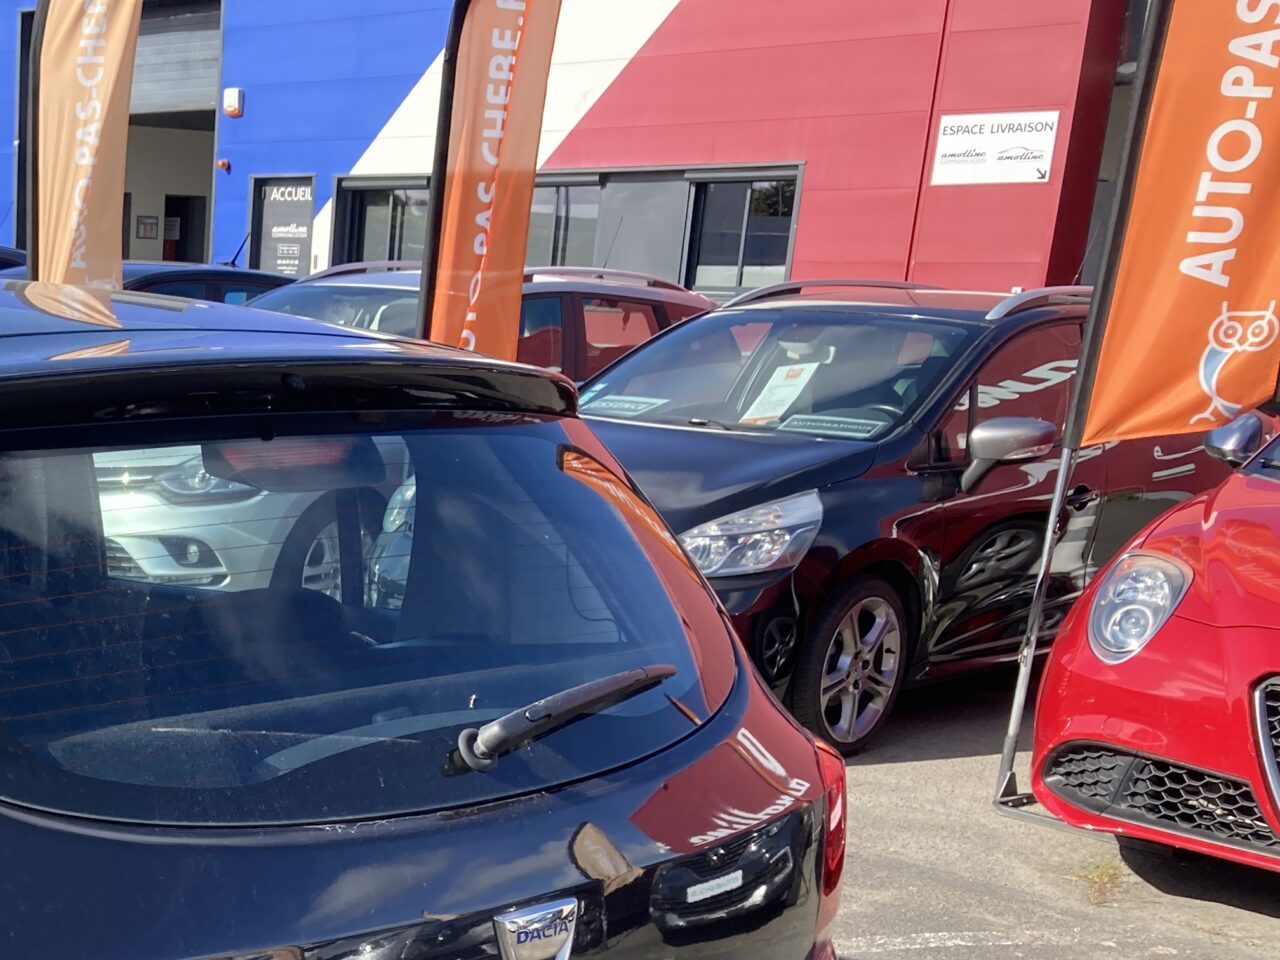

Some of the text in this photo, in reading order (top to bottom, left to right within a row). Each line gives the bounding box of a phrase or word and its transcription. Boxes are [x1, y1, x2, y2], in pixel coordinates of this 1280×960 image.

[942, 121, 1055, 136] ESPACE LIVRAISON
[271, 187, 312, 200] ACCUEIL
[516, 920, 571, 946] DACIA
